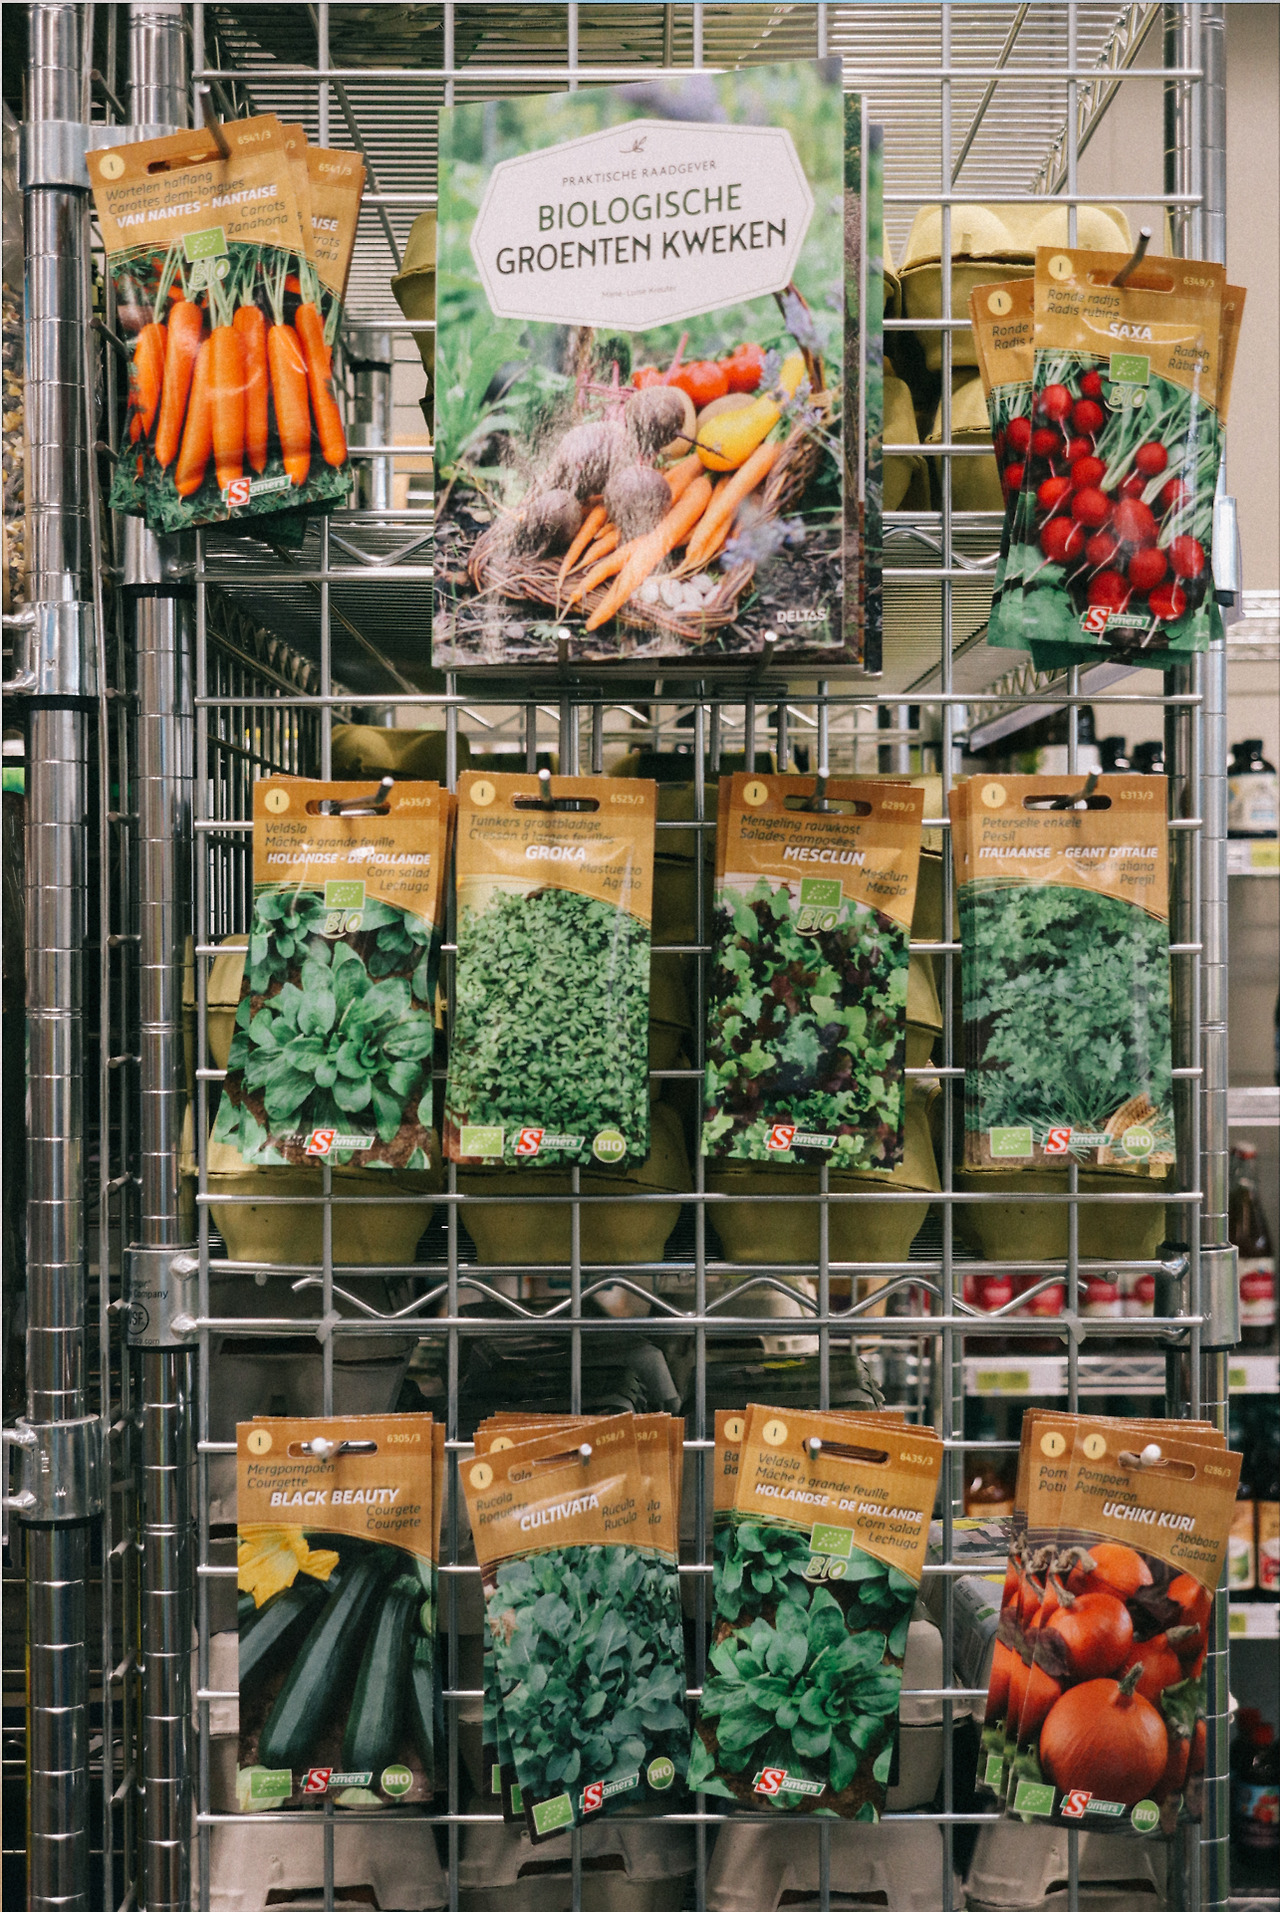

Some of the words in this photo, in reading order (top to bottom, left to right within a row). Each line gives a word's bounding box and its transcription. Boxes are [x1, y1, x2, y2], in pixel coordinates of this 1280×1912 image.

[318, 163, 352, 175] 6541/3
[562, 170, 638, 187] PRAKTISCHE
[642, 160, 717, 178] RAADGEVER
[106, 180, 159, 201] Wortelen
[163, 171, 212, 194] halflang
[109, 195, 160, 215] Carottes
[164, 178, 245, 204] demi-longues
[117, 214, 146, 229] VAN
[148, 203, 201, 222] NANTES
[212, 184, 278, 209] NANTAISE
[241, 202, 286, 218] Carrots
[538, 183, 742, 232] BIOLOGISCHE
[228, 214, 288, 235] Zanahoria
[310, 217, 338, 232] AISE
[496, 233, 651, 275] GROENTEN
[663, 218, 787, 259] KWEKEN
[1183, 276, 1215, 288] 6349/3
[1048, 289, 1085, 303] Ronde
[1087, 293, 1120, 307] radijs
[1047, 303, 1079, 316] Radis
[1083, 307, 1120, 320] rubine
[992, 323, 1029, 336] Ronde
[1109, 323, 1152, 340] SAXA
[994, 337, 1023, 350] Radis
[1174, 345, 1210, 360] Radish
[1110, 386, 1147, 408] BIO
[229, 478, 286, 504] Somers
[777, 608, 827, 623] DELTAS
[1086, 608, 1143, 632] Somers
[610, 794, 645, 805] 6525/3
[1120, 791, 1154, 800] 6313/3
[265, 823, 307, 834] Veldsla
[470, 814, 521, 828] Tuinkers
[524, 817, 601, 832] grootbladige
[740, 815, 802, 831] Mengeling
[805, 822, 861, 835] rauwkost
[982, 817, 1040, 829] Peterselie
[1043, 818, 1083, 829] enkele
[265, 836, 303, 847] Mâche
[317, 837, 357, 849] grande
[360, 836, 395, 847] feuille
[469, 828, 517, 841] Cresson
[532, 831, 569, 845] larges
[740, 828, 786, 842] Salades
[982, 830, 1015, 841] Persil
[267, 853, 338, 864] HOLLANDSE
[366, 853, 431, 865] HOLLANDE
[525, 845, 586, 861] GROKA
[784, 846, 866, 866] MESCLUN
[979, 847, 1051, 859] ITALIAANSE
[1065, 847, 1107, 859] GEANT
[367, 866, 394, 877] Corn
[399, 866, 430, 878] salad
[860, 868, 909, 882] Mesclun
[1120, 874, 1155, 886] Perejil
[380, 879, 429, 894] Lechuga
[866, 882, 907, 896] Mezcla
[325, 911, 363, 933] BIO
[797, 910, 839, 932] BIO
[311, 1131, 367, 1154] Somers
[519, 1131, 577, 1154] Somers
[598, 1139, 623, 1153] BIO
[771, 1127, 829, 1149] Somers
[1048, 1129, 1106, 1153] Somers
[1126, 1135, 1150, 1148] BIO
[133, 1290, 169, 1300] Company
[387, 1434, 421, 1444] 6305/3
[635, 1431, 658, 1441] 58/3
[759, 1453, 801, 1470] Veldsla
[900, 1452, 934, 1466] 6435/3
[247, 1463, 335, 1476] Mergpompoen
[1077, 1467, 1130, 1487] Pompoen
[247, 1477, 308, 1490] Courgette
[755, 1466, 795, 1483] Mâche
[808, 1476, 851, 1494] grande
[853, 1483, 890, 1500] feuille
[270, 1490, 326, 1507] BLACK
[331, 1488, 400, 1505] BEAUTY
[1075, 1481, 1138, 1503] Potimarron
[477, 1492, 513, 1511] Rucola
[755, 1484, 829, 1507] HOLLANDSE
[838, 1498, 856, 1512] DE
[857, 1502, 924, 1523] HOLLANDE
[366, 1504, 421, 1518] Courgete
[480, 1502, 528, 1526] Roquette
[520, 1494, 599, 1531] CULTIVATA
[1103, 1503, 1156, 1526] UCHIKI
[1158, 1514, 1196, 1532] KURI
[366, 1518, 421, 1530] Courgete
[857, 1515, 886, 1529] Corn
[889, 1520, 921, 1536] salad
[868, 1531, 918, 1550] Lechuga
[1170, 1545, 1217, 1563] Calabaza
[807, 1556, 847, 1580] BIO
[308, 1770, 365, 1792] Somers
[385, 1774, 410, 1786] BIO
[651, 1764, 672, 1781] BIO
[759, 1770, 818, 1793] Somers
[586, 1779, 634, 1809] Somers
[1066, 1792, 1119, 1816] Somers
[1135, 1808, 1157, 1822] BIO
